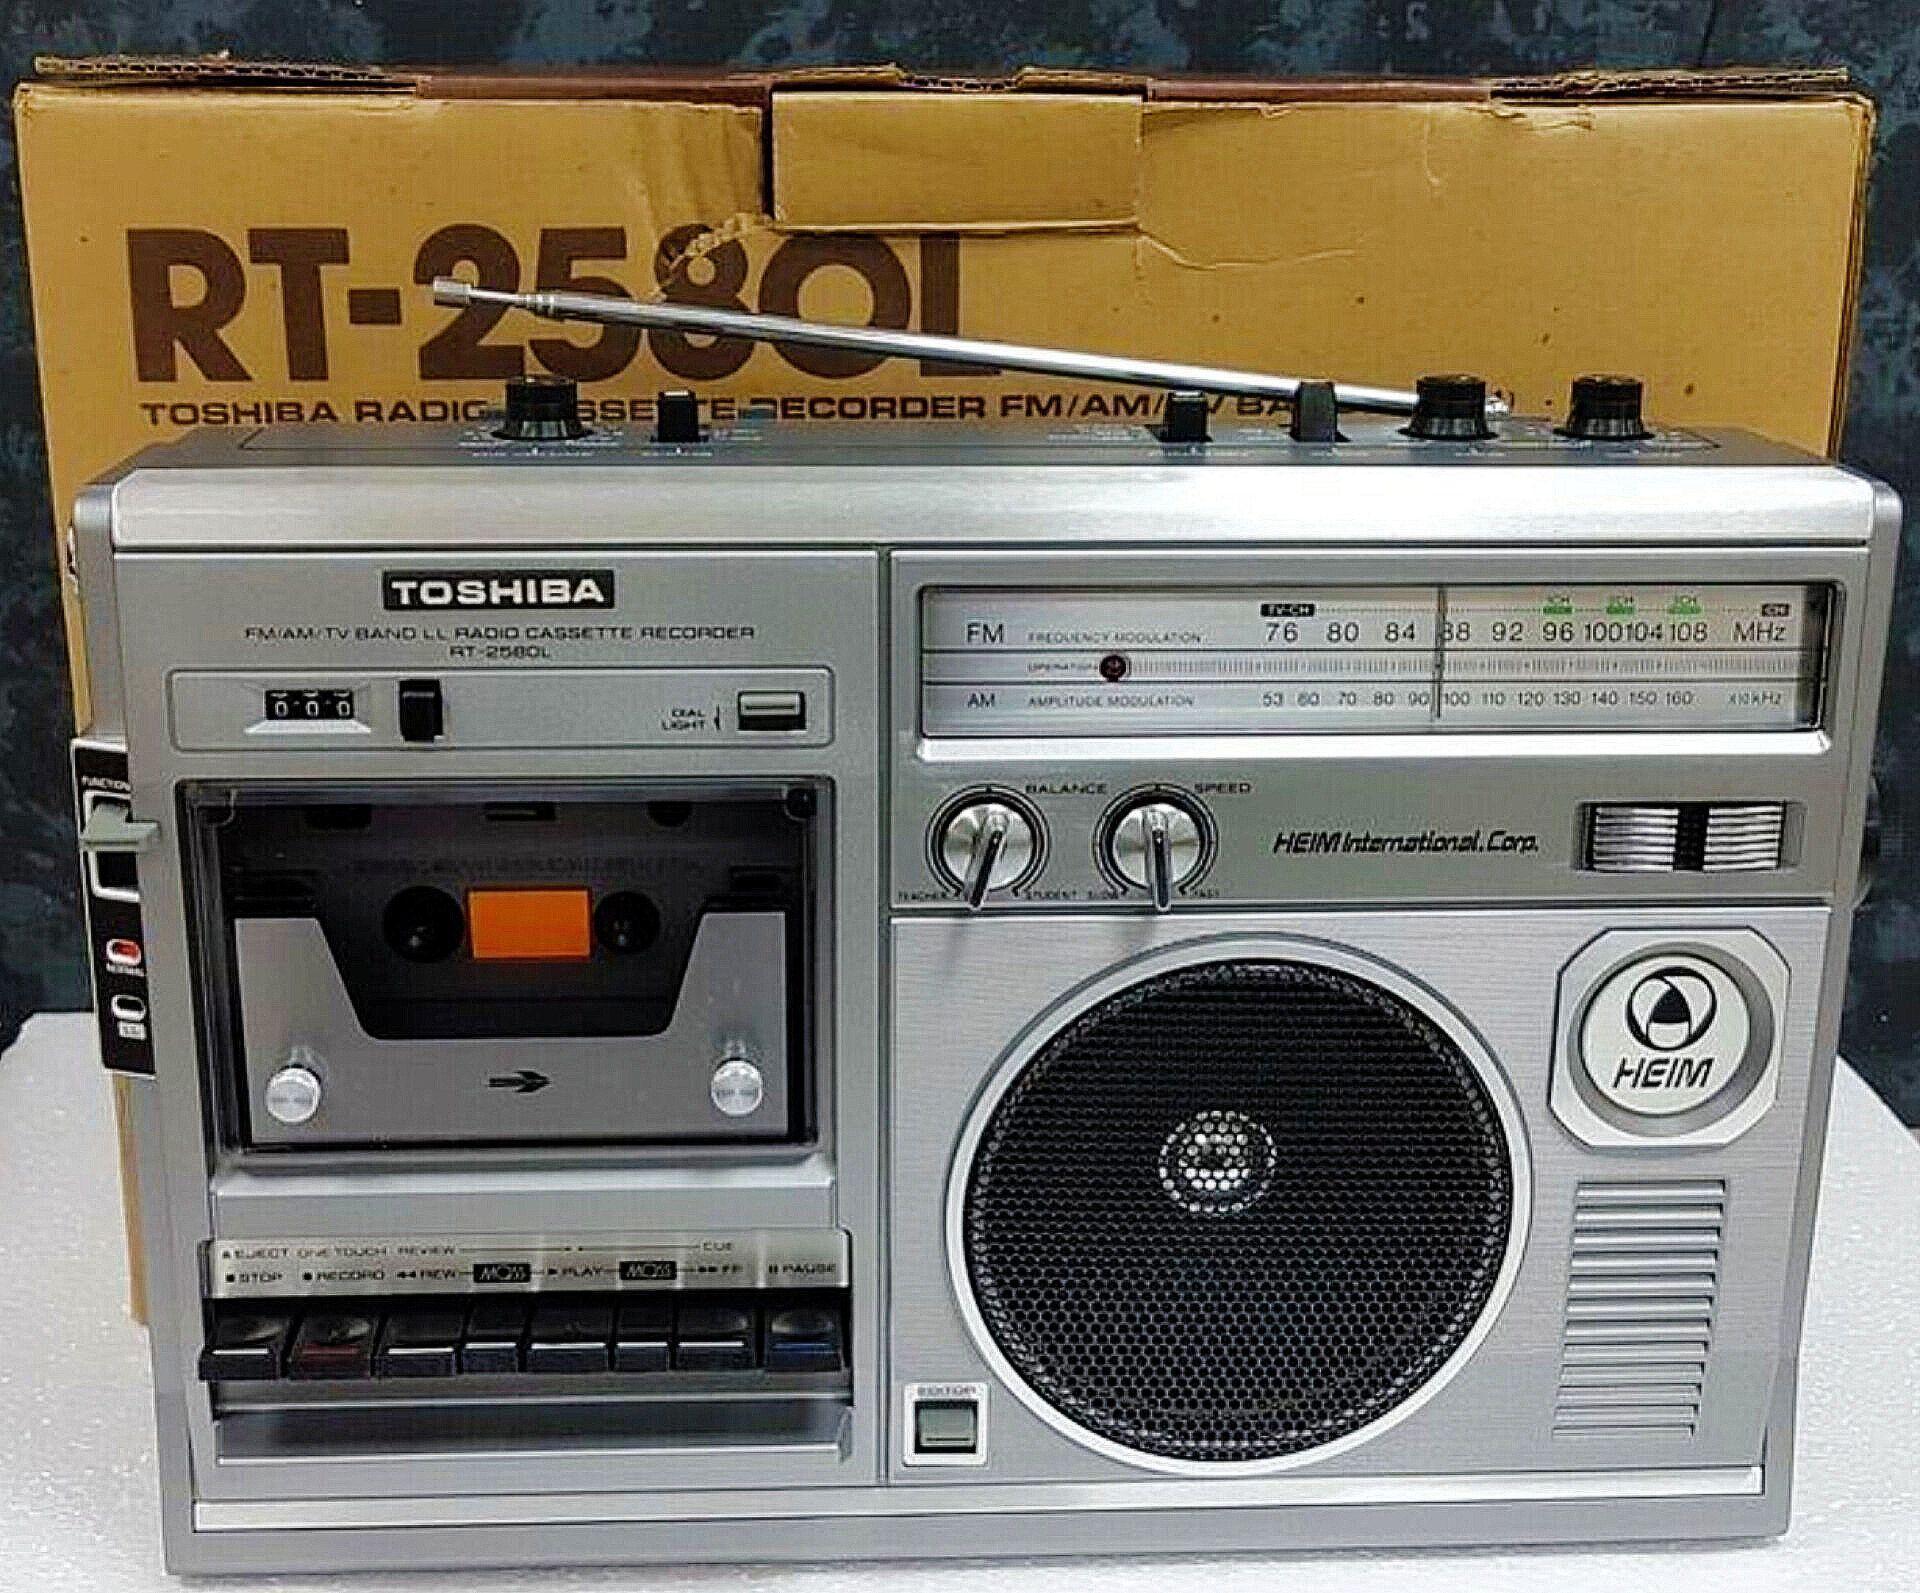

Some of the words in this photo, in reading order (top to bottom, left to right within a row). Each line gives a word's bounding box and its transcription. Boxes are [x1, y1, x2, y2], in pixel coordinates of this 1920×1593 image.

[127, 224, 1001, 382] RT-2580L
[141, 402, 336, 425] TOSHIBA
[390, 579, 606, 606] TOSHIBA
[355, 627, 416, 641] BAND
[454, 626, 519, 640] RADIO
[525, 626, 634, 640] CASSETTE
[641, 626, 755, 640] RECORDER
[966, 623, 1005, 644] FM
[1265, 622, 1299, 642] 76
[1326, 622, 1360, 642] 80
[1384, 622, 1415, 642] 84
[1491, 622, 1524, 641] 92
[1542, 622, 1574, 641] 96
[1670, 622, 1708, 641] 108
[1733, 621, 1786, 641] MHz
[967, 693, 995, 708] AM
[1338, 691, 1357, 707] 70
[1373, 691, 1394, 706] 80
[1444, 691, 1470, 706] 100
[1482, 692, 1506, 706] 110
[1518, 692, 1545, 706] 120
[1553, 692, 1581, 706] 130
[1591, 692, 1618, 706] 140
[1629, 692, 1657, 705] 150
[1666, 692, 1692, 705] 160
[1025, 783, 1108, 795] BALANCE
[1194, 782, 1253, 795] SPEED
[1273, 831, 1342, 854] HEIM
[1612, 1057, 1716, 1089] HEIM
[561, 1267, 602, 1278] PLAY
